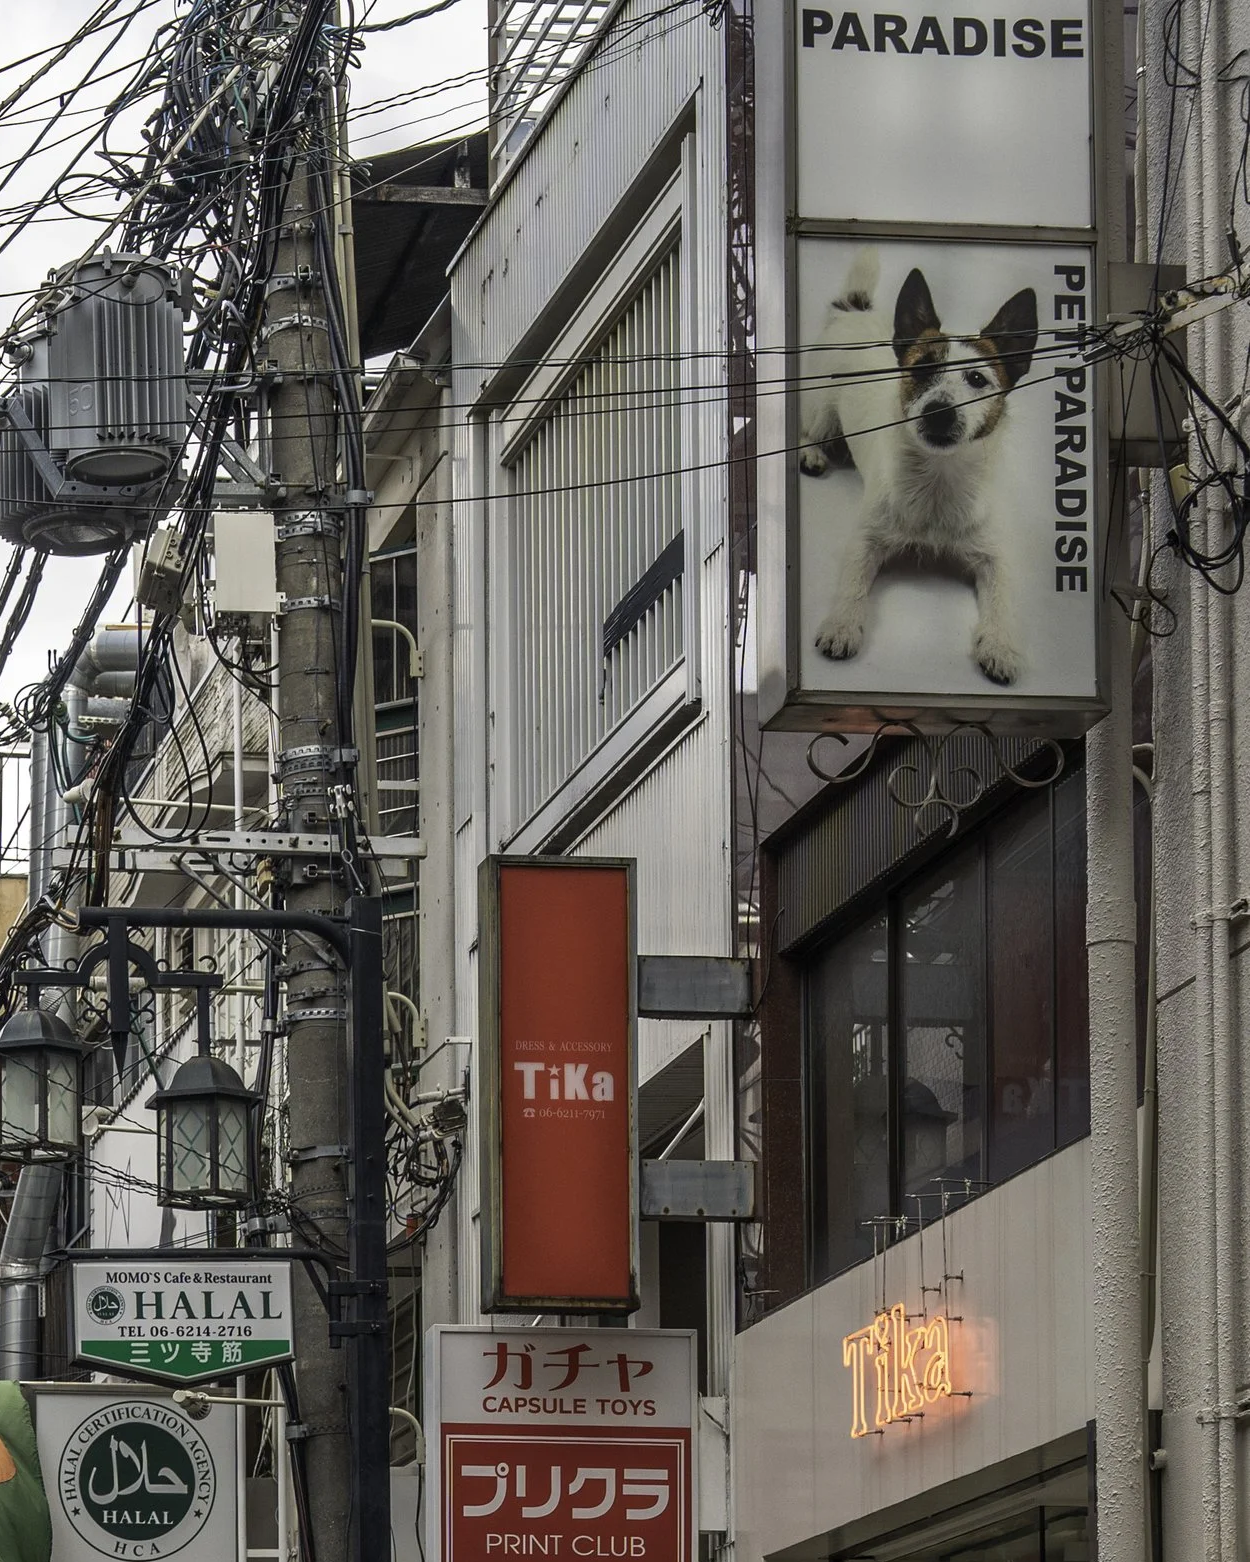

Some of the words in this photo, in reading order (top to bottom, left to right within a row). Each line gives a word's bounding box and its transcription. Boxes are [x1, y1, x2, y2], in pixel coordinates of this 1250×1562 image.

[803, 9, 1084, 58] PARADISE
[1054, 366, 1088, 593] PARADISE
[515, 1040, 545, 1051] DRESS
[560, 1041, 613, 1053] ACCESSORY
[539, 1107, 606, 1119] 06-6211-7971
[164, 1272, 191, 1284] Cafe
[193, 1272, 202, 1284] &
[204, 1272, 272, 1284] Restaurant
[133, 1291, 283, 1319] HALAL
[118, 1326, 145, 1337] TEL
[150, 1326, 252, 1337] 06-6214-2716
[130, 1341, 242, 1363] 三ツ寺筋
[482, 1342, 655, 1394] ガチャ
[843, 1303, 951, 1438] Tika
[482, 1396, 587, 1416] CAPSULE
[596, 1398, 657, 1417] TOYS
[64, 1448, 82, 1500] HALAL
[78, 1406, 189, 1444] CERTIFICATION
[186, 1440, 211, 1505] AGENCY
[88, 1435, 188, 1505] حلال
[461, 1462, 670, 1521] プリクラ
[102, 1510, 174, 1525] HALAL
[485, 1533, 563, 1556] PRINT
[571, 1534, 646, 1558] CLUB
